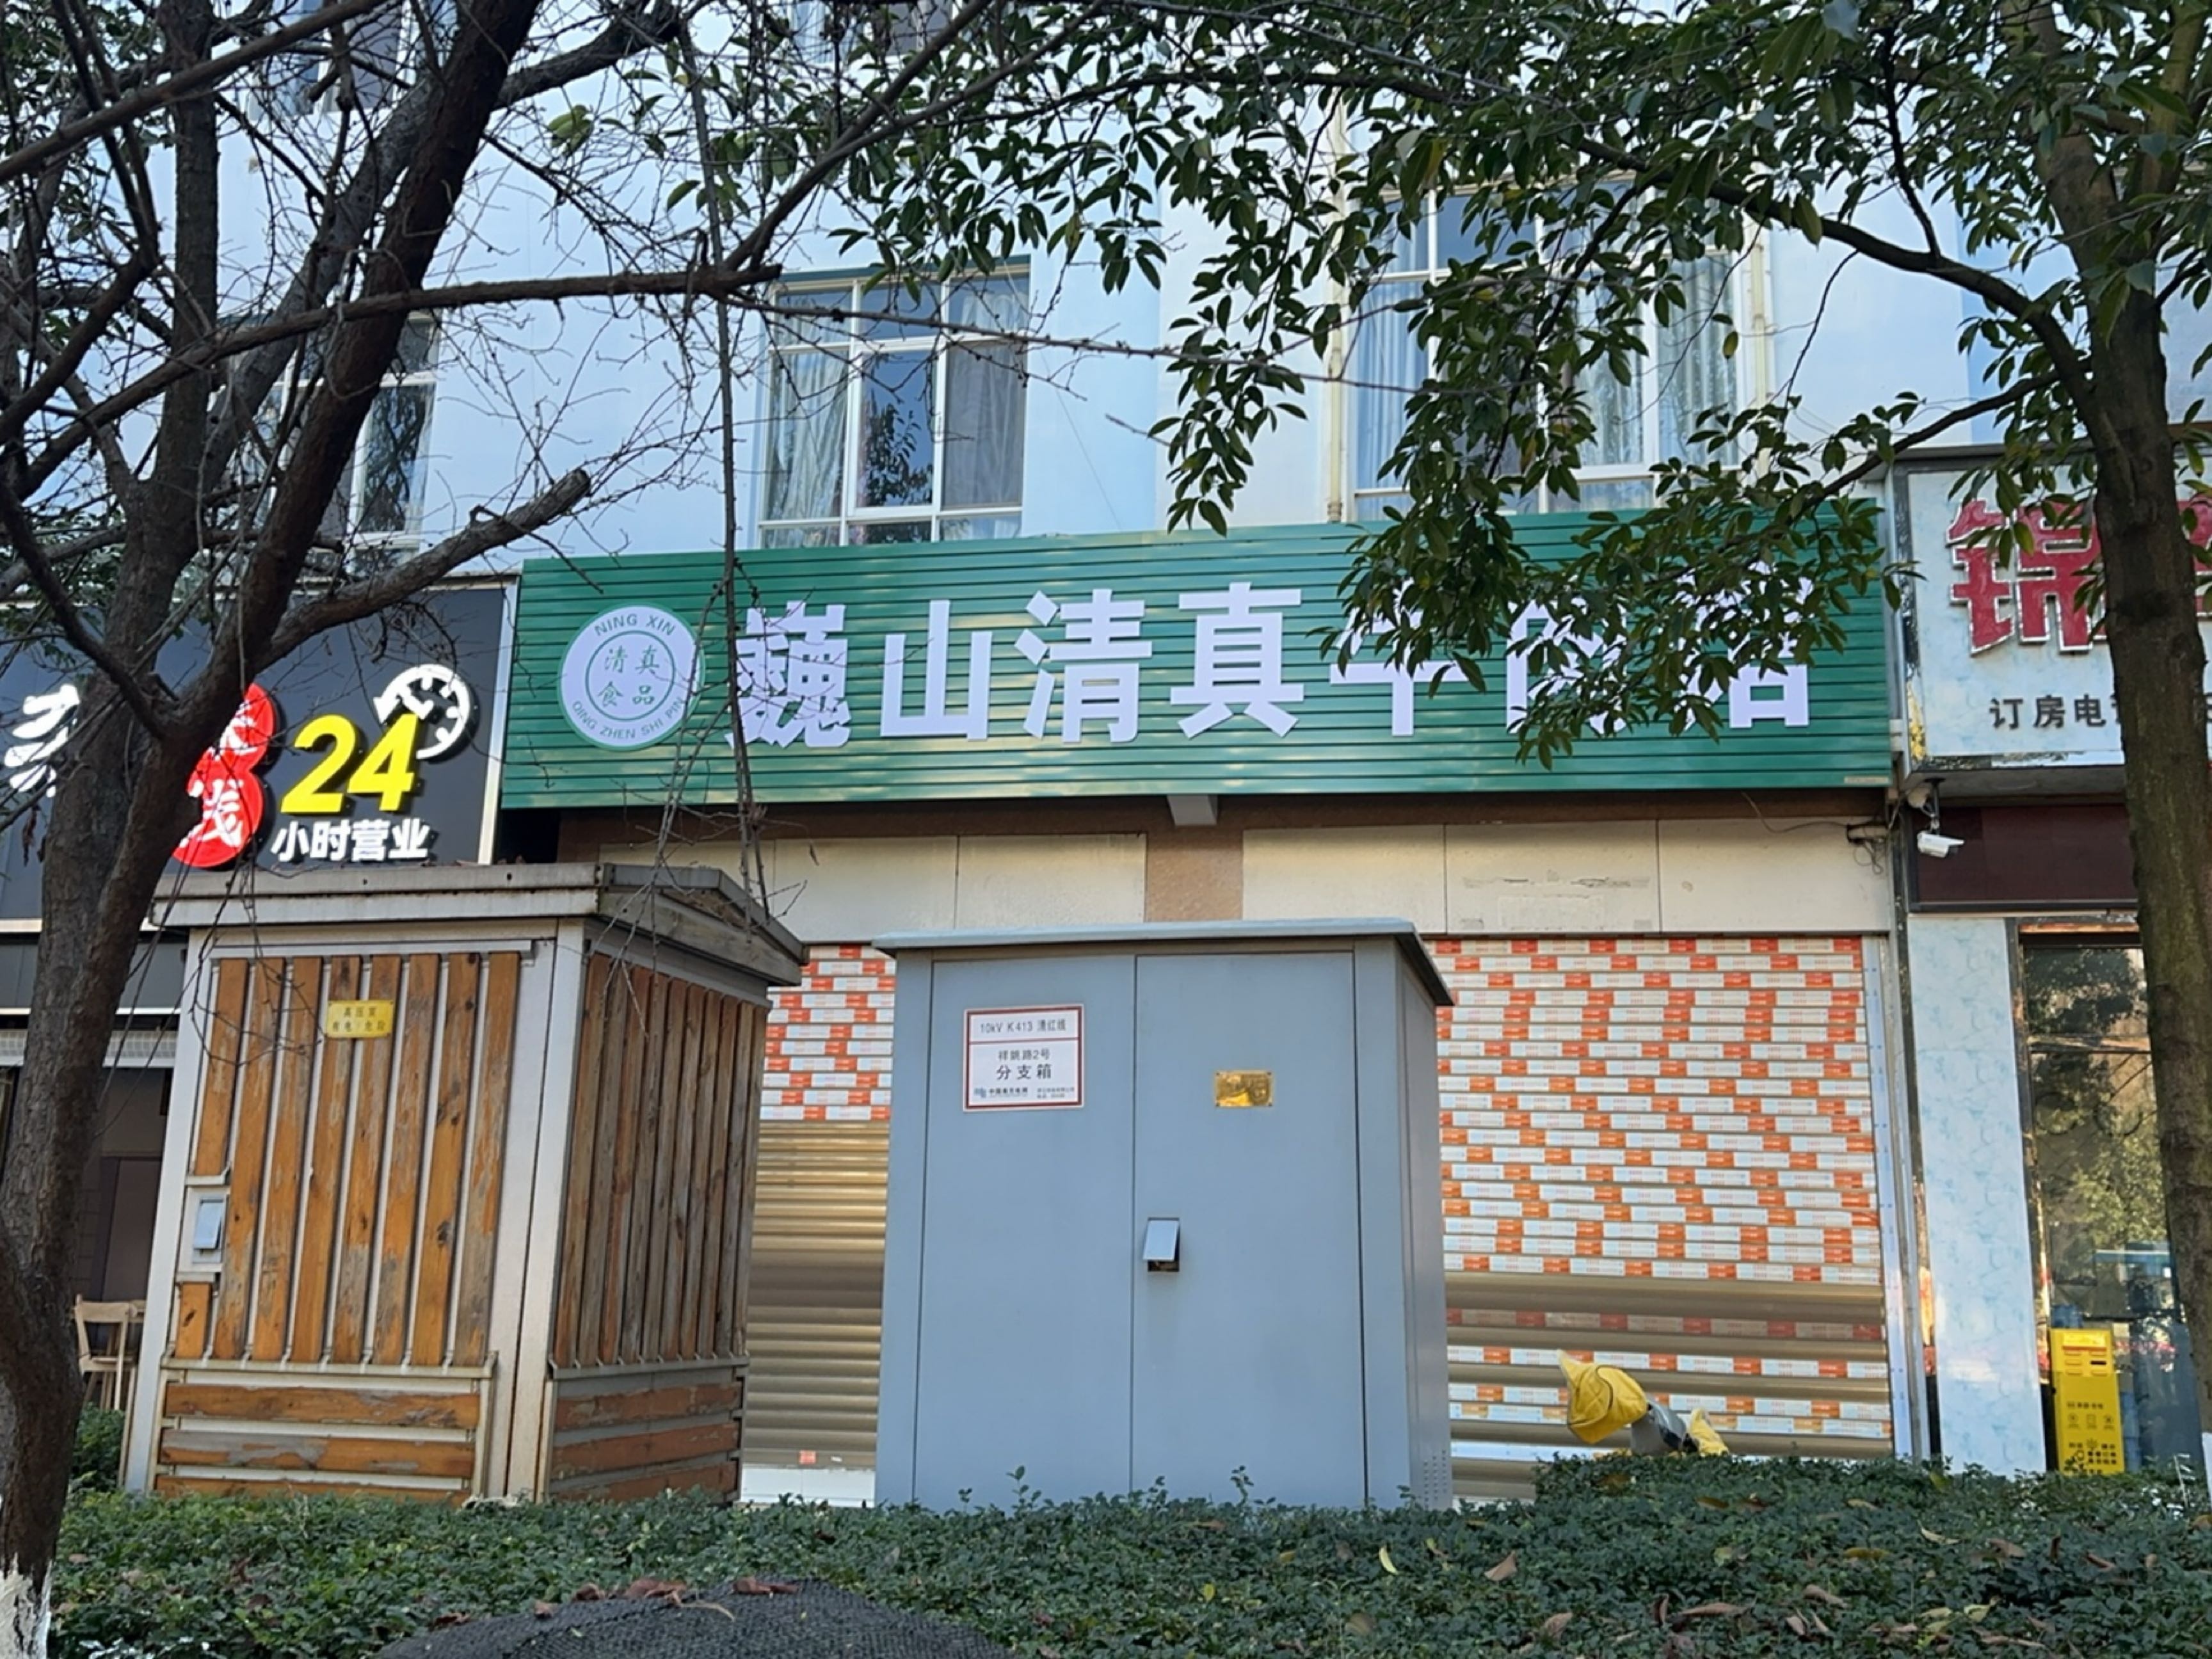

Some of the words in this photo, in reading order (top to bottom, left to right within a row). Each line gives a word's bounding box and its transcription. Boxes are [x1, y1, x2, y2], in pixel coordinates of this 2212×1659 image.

[595, 614, 637, 636] NING
[646, 614, 676, 636] XIN
[604, 645, 660, 674] 清真
[597, 681, 655, 707] 食品
[572, 700, 598, 730] QING
[599, 726, 636, 739] ZHEN
[640, 717, 664, 735] SHI
[664, 695, 685, 719] PIN
[280, 714, 417, 813] 24
[270, 817, 431, 862] 小时营业
[996, 1063, 1052, 1080] 分支箱
